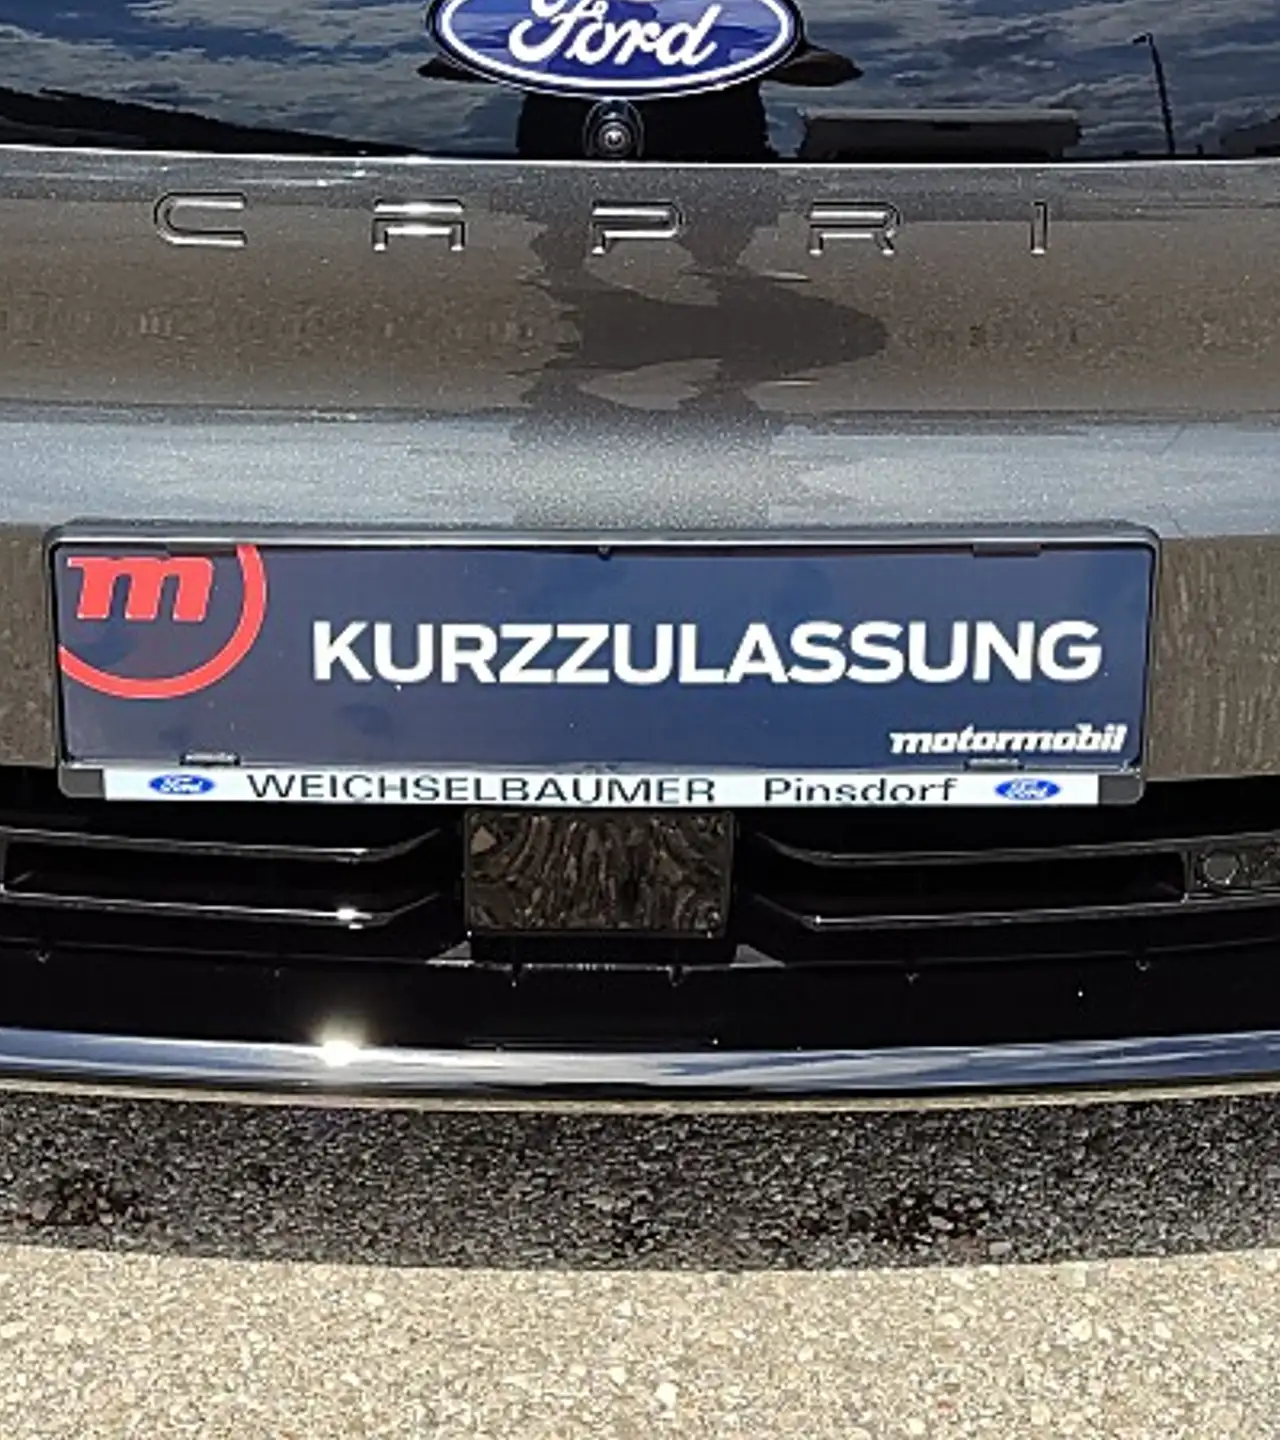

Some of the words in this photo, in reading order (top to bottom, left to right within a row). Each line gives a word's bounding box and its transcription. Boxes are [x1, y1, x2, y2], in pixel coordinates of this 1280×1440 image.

[153, 190, 1049, 254] CAPRI
[313, 619, 1102, 685] KURZZULASSUNG
[889, 723, 1129, 755] motormobil
[247, 773, 715, 804] WEICHSELBAUMER
[764, 778, 958, 804] Pinsdorf
